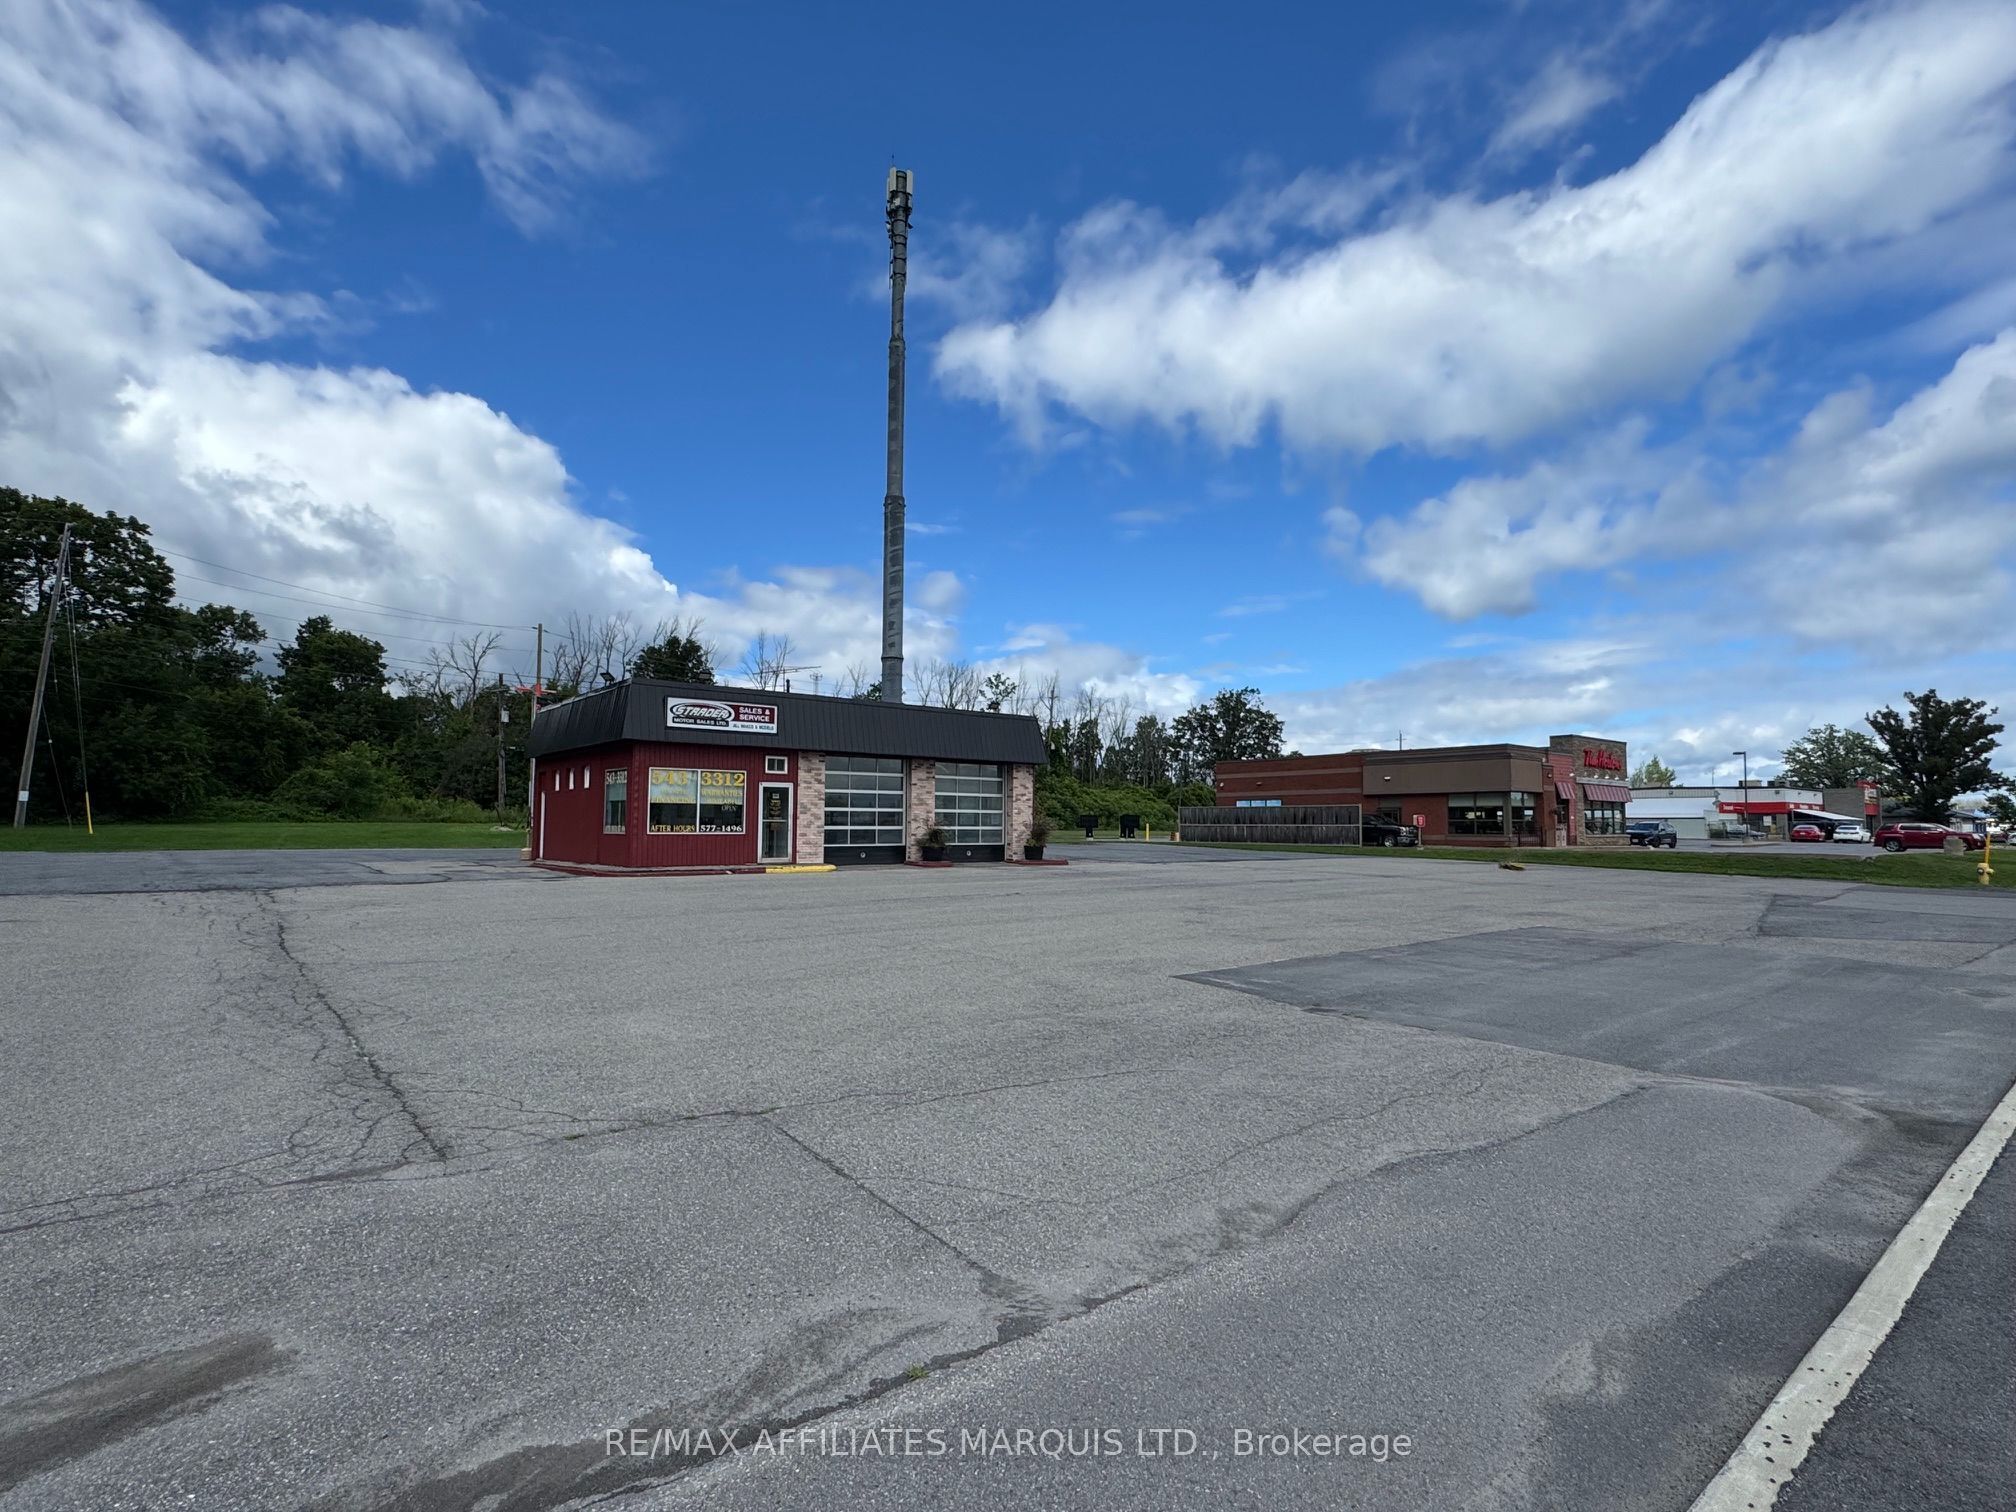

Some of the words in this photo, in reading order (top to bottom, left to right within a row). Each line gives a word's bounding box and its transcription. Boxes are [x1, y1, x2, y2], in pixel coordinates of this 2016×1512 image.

[674, 706, 730, 719] STRADER
[739, 707, 763, 715] SALES
[739, 714, 770, 722] SERVICE
[702, 772, 745, 787] 3312
[651, 824, 672, 832] AFTER
[673, 824, 696, 833] HOURS
[700, 824, 743, 832] 577-1496
